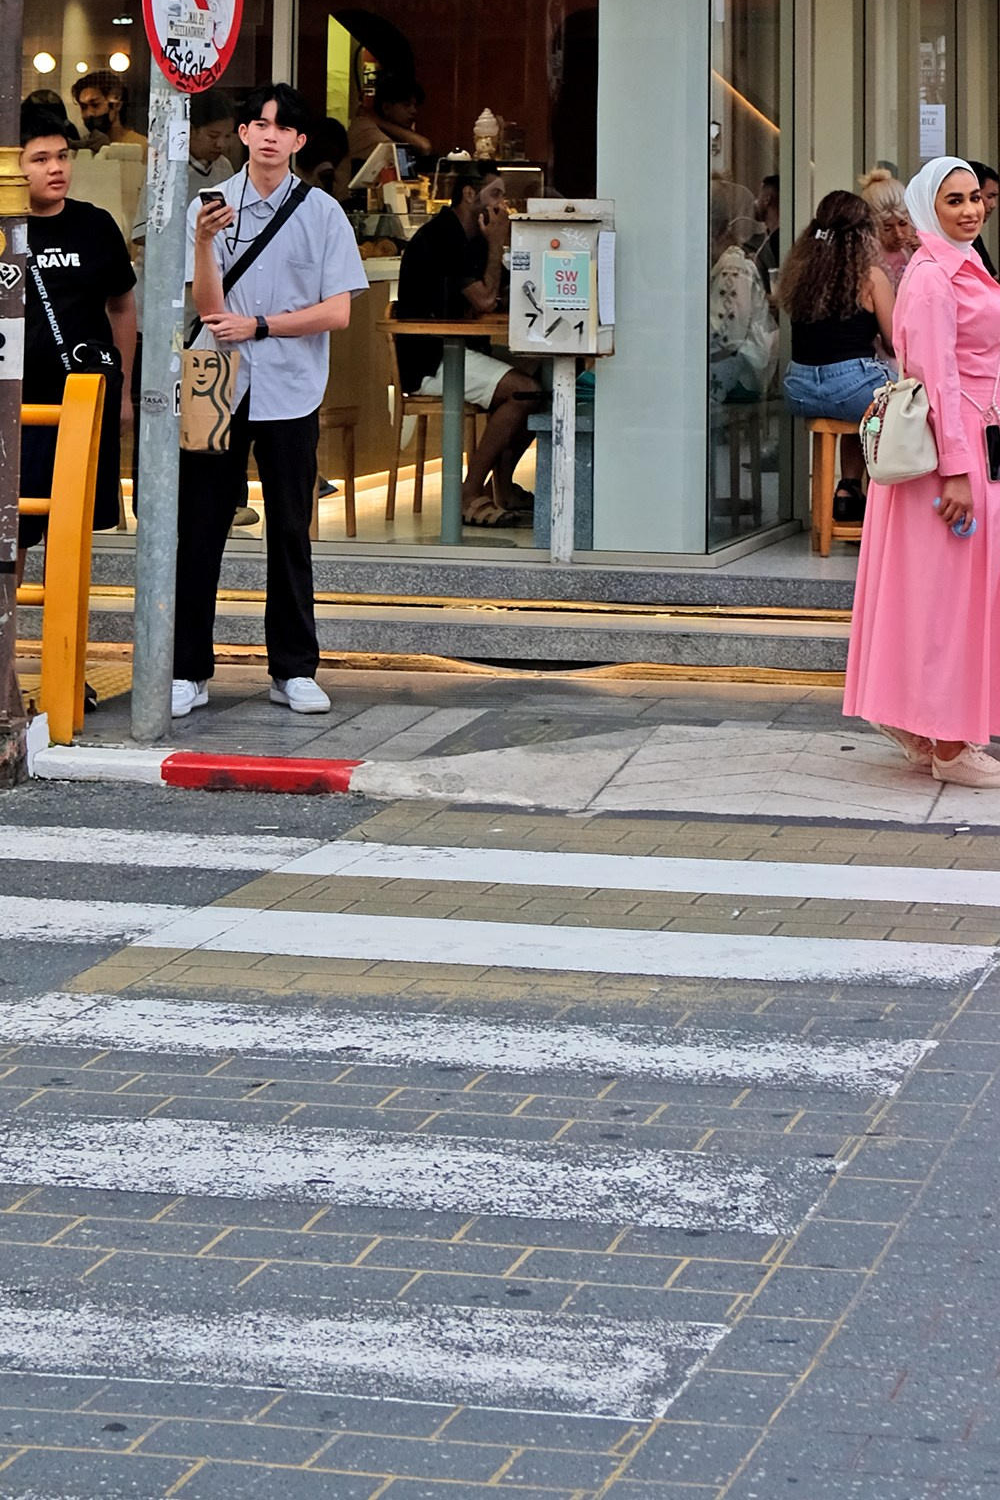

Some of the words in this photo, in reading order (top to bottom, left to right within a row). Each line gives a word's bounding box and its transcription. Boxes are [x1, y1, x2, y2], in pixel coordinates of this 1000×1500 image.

[555, 270, 578, 282] SW
[556, 283, 578, 296] 169
[30, 264, 49, 300] UNDER
[43, 300, 64, 346] ARMOUR
